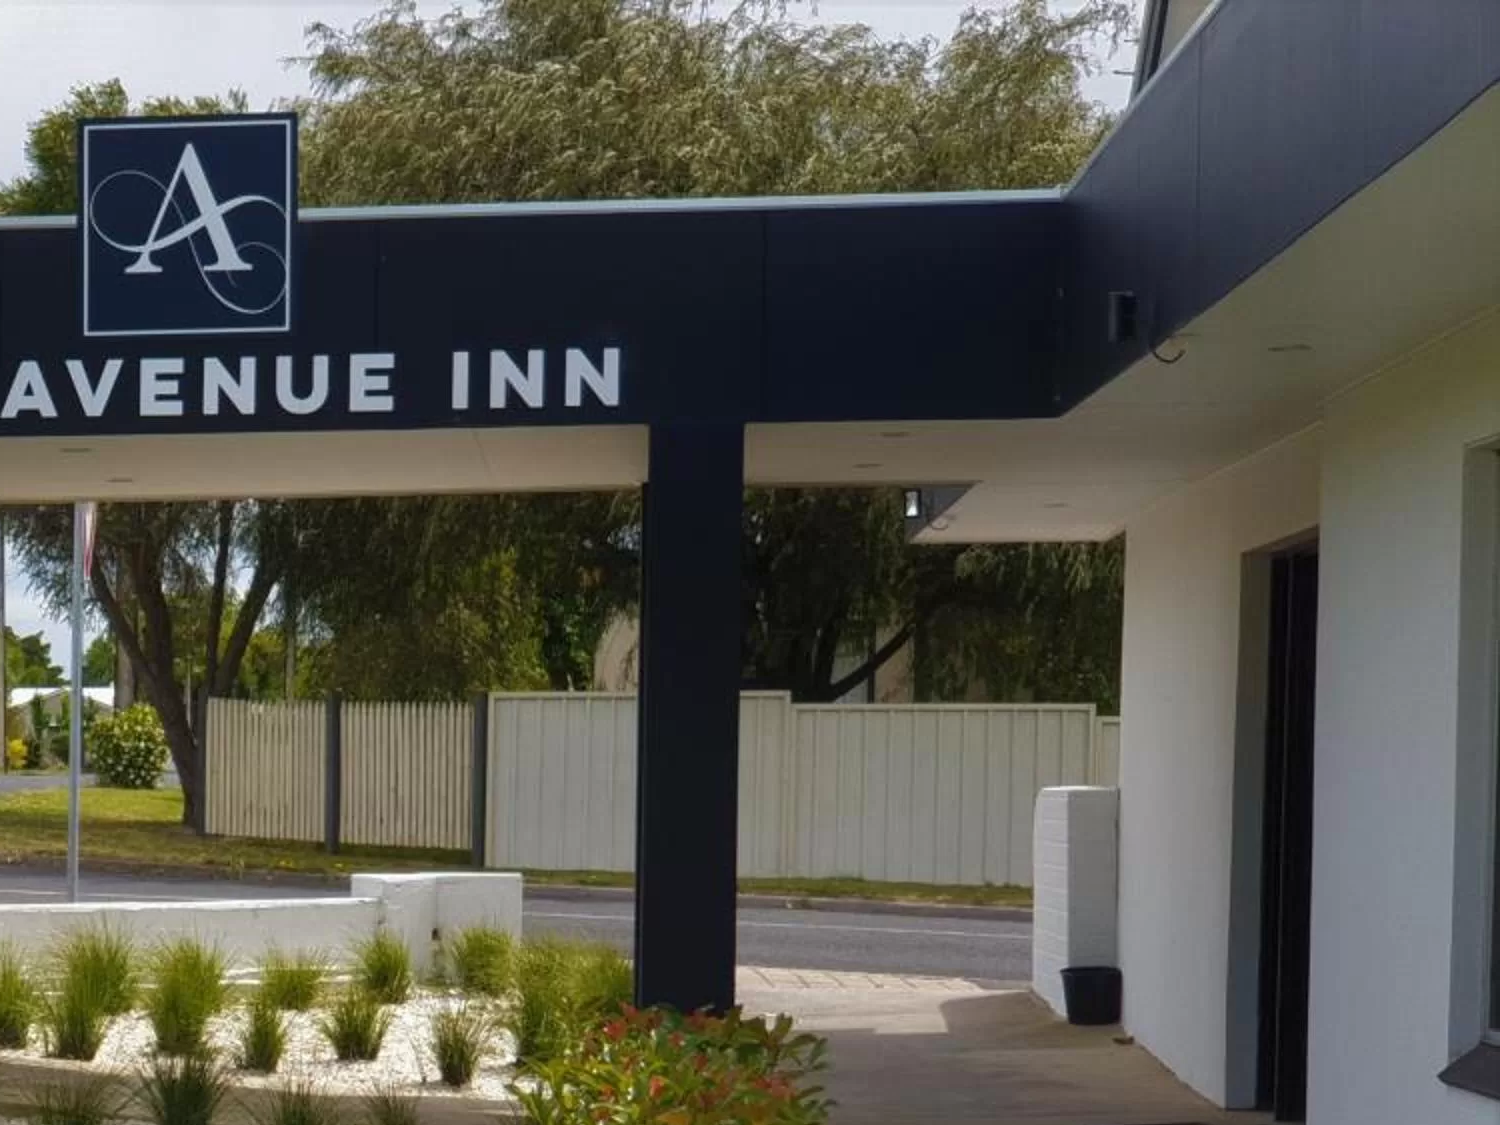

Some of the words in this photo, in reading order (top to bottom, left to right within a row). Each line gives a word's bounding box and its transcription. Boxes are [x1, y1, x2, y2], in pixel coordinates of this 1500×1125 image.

[89, 142, 288, 314] A
[0, 353, 395, 419] AVENUE
[451, 347, 621, 410] INN
